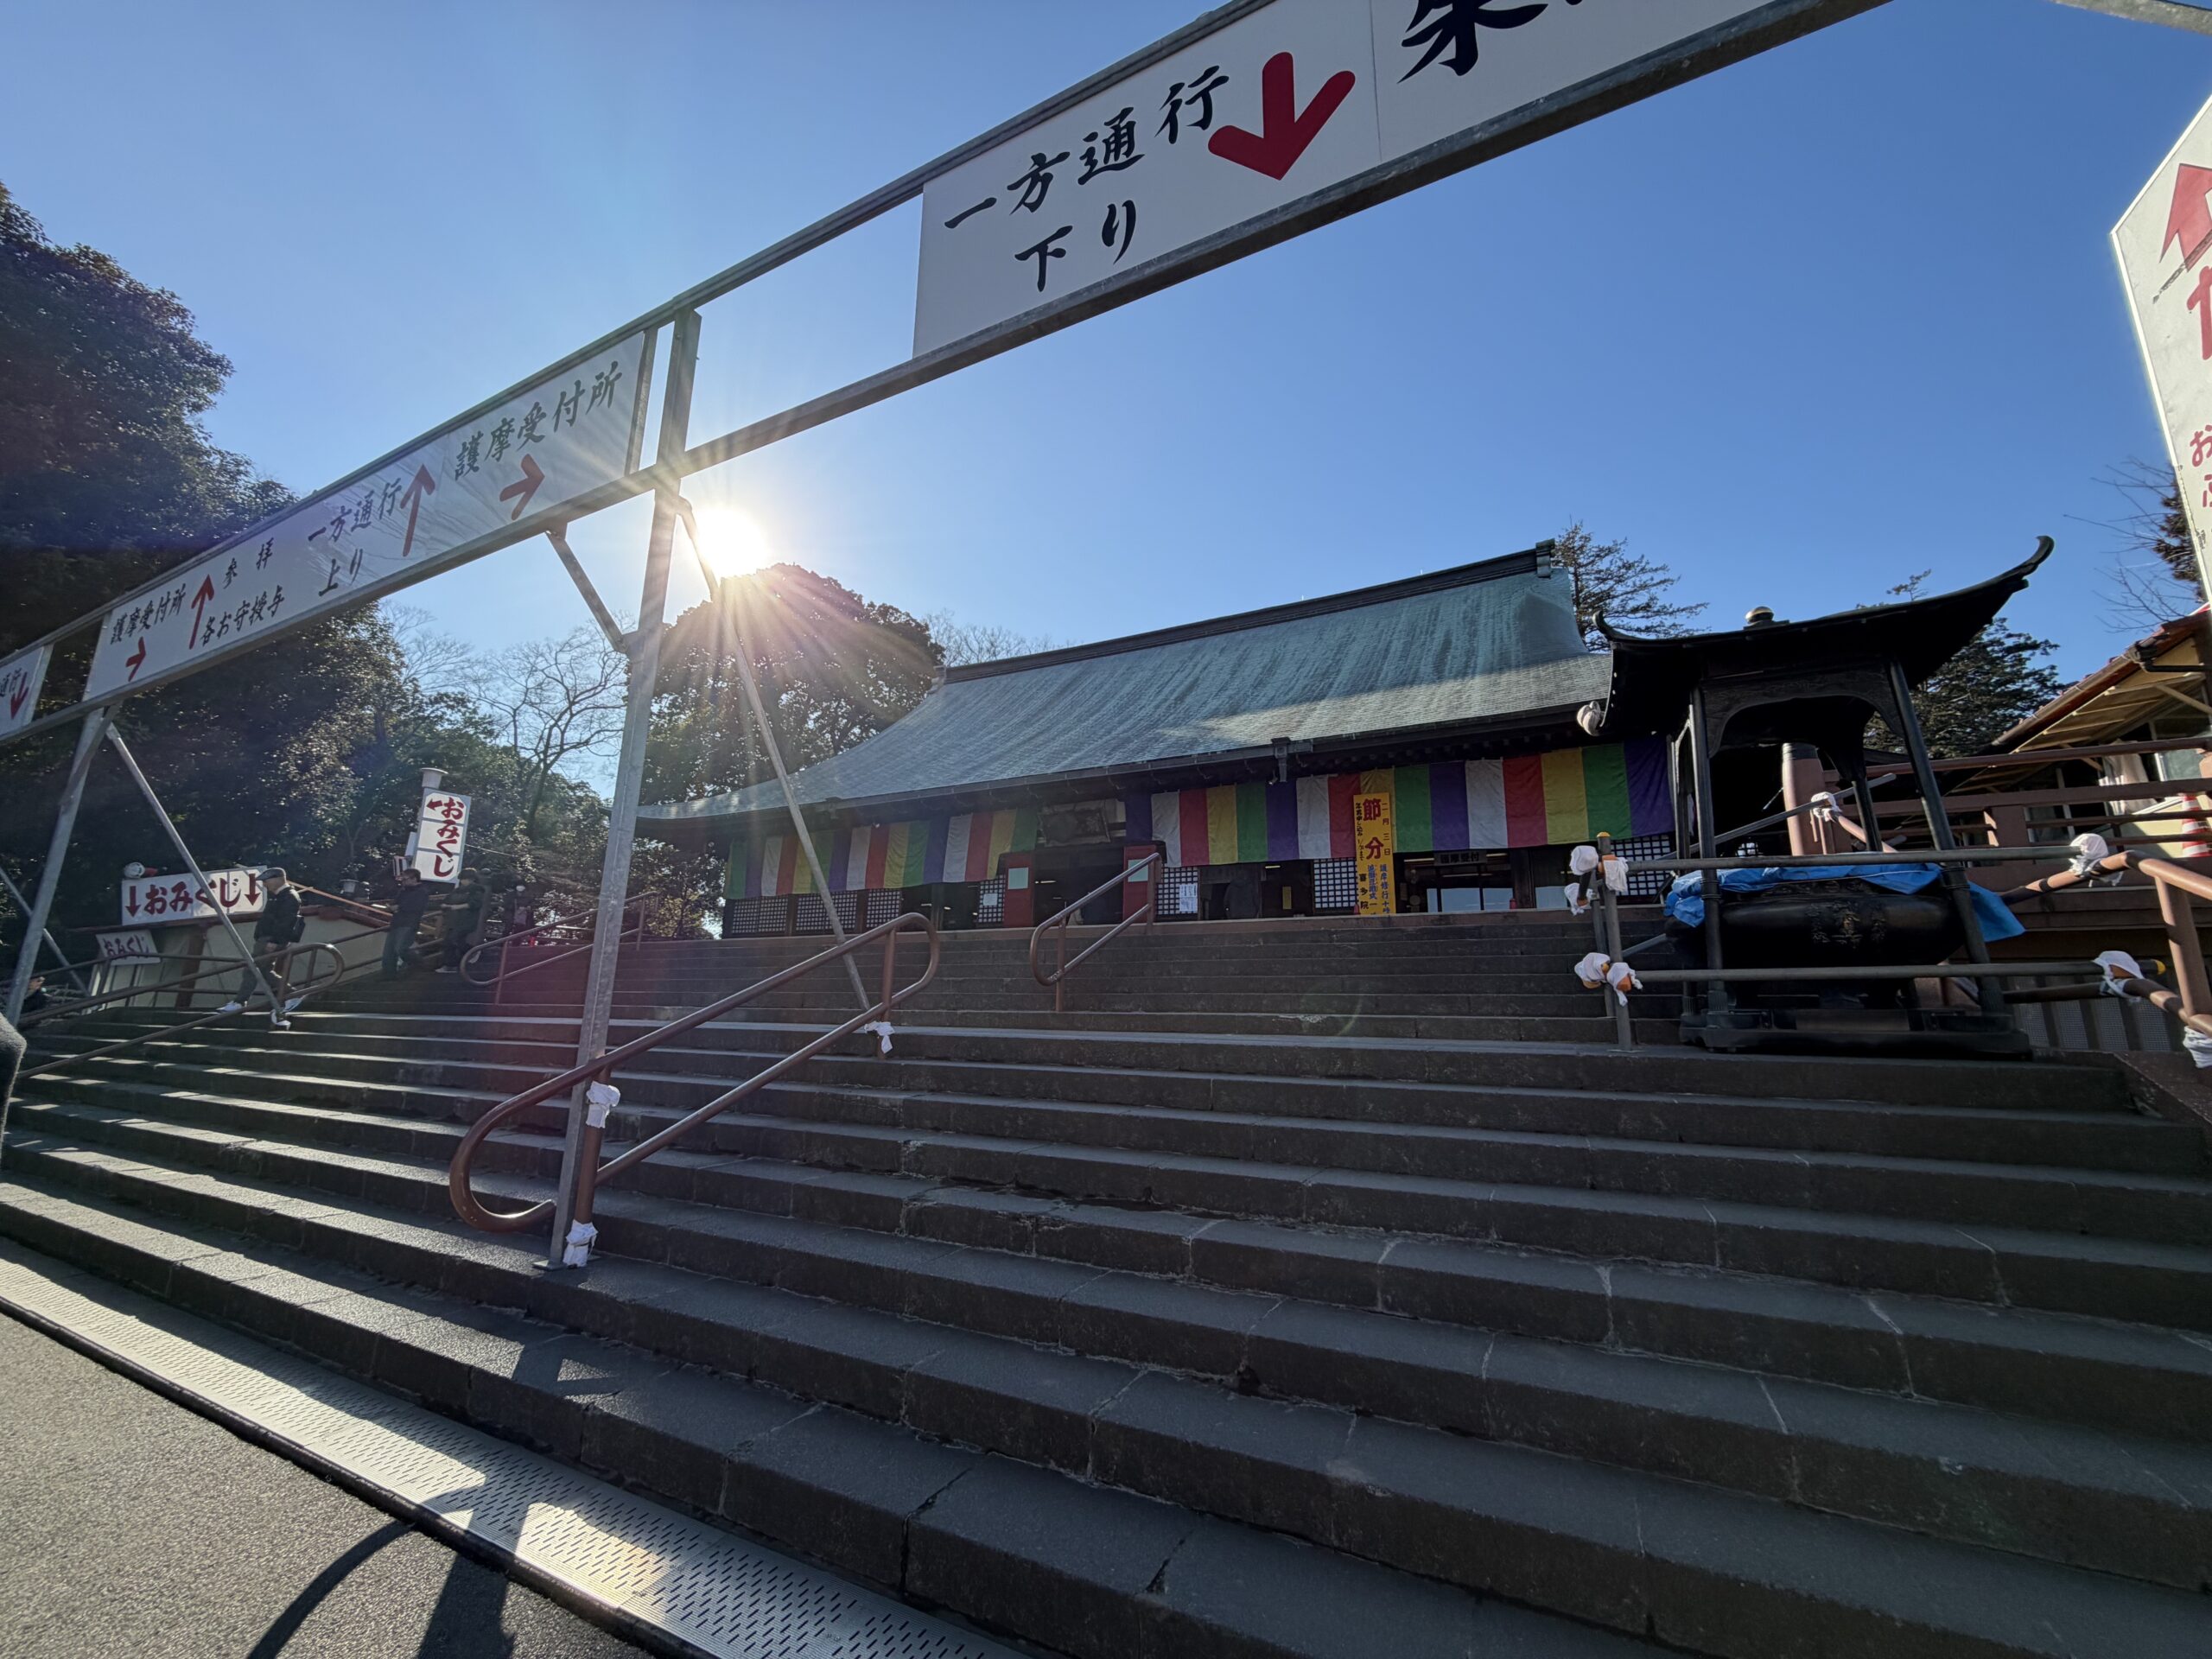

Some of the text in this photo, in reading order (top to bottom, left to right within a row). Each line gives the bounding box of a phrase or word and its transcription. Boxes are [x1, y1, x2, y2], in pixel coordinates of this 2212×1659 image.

[944, 65, 1230, 231] 一方通行
[1014, 199, 1138, 293] 下り
[454, 360, 623, 481] 護摩受付所
[308, 477, 403, 543] 一方通行
[318, 548, 364, 597] 上り
[110, 582, 187, 645] 護摩受付所
[435, 796, 465, 878] おみくじ
[1362, 798, 1384, 861] 節分
[1382, 802, 1391, 856] 二月三日
[143, 877, 243, 916] おみくじ
